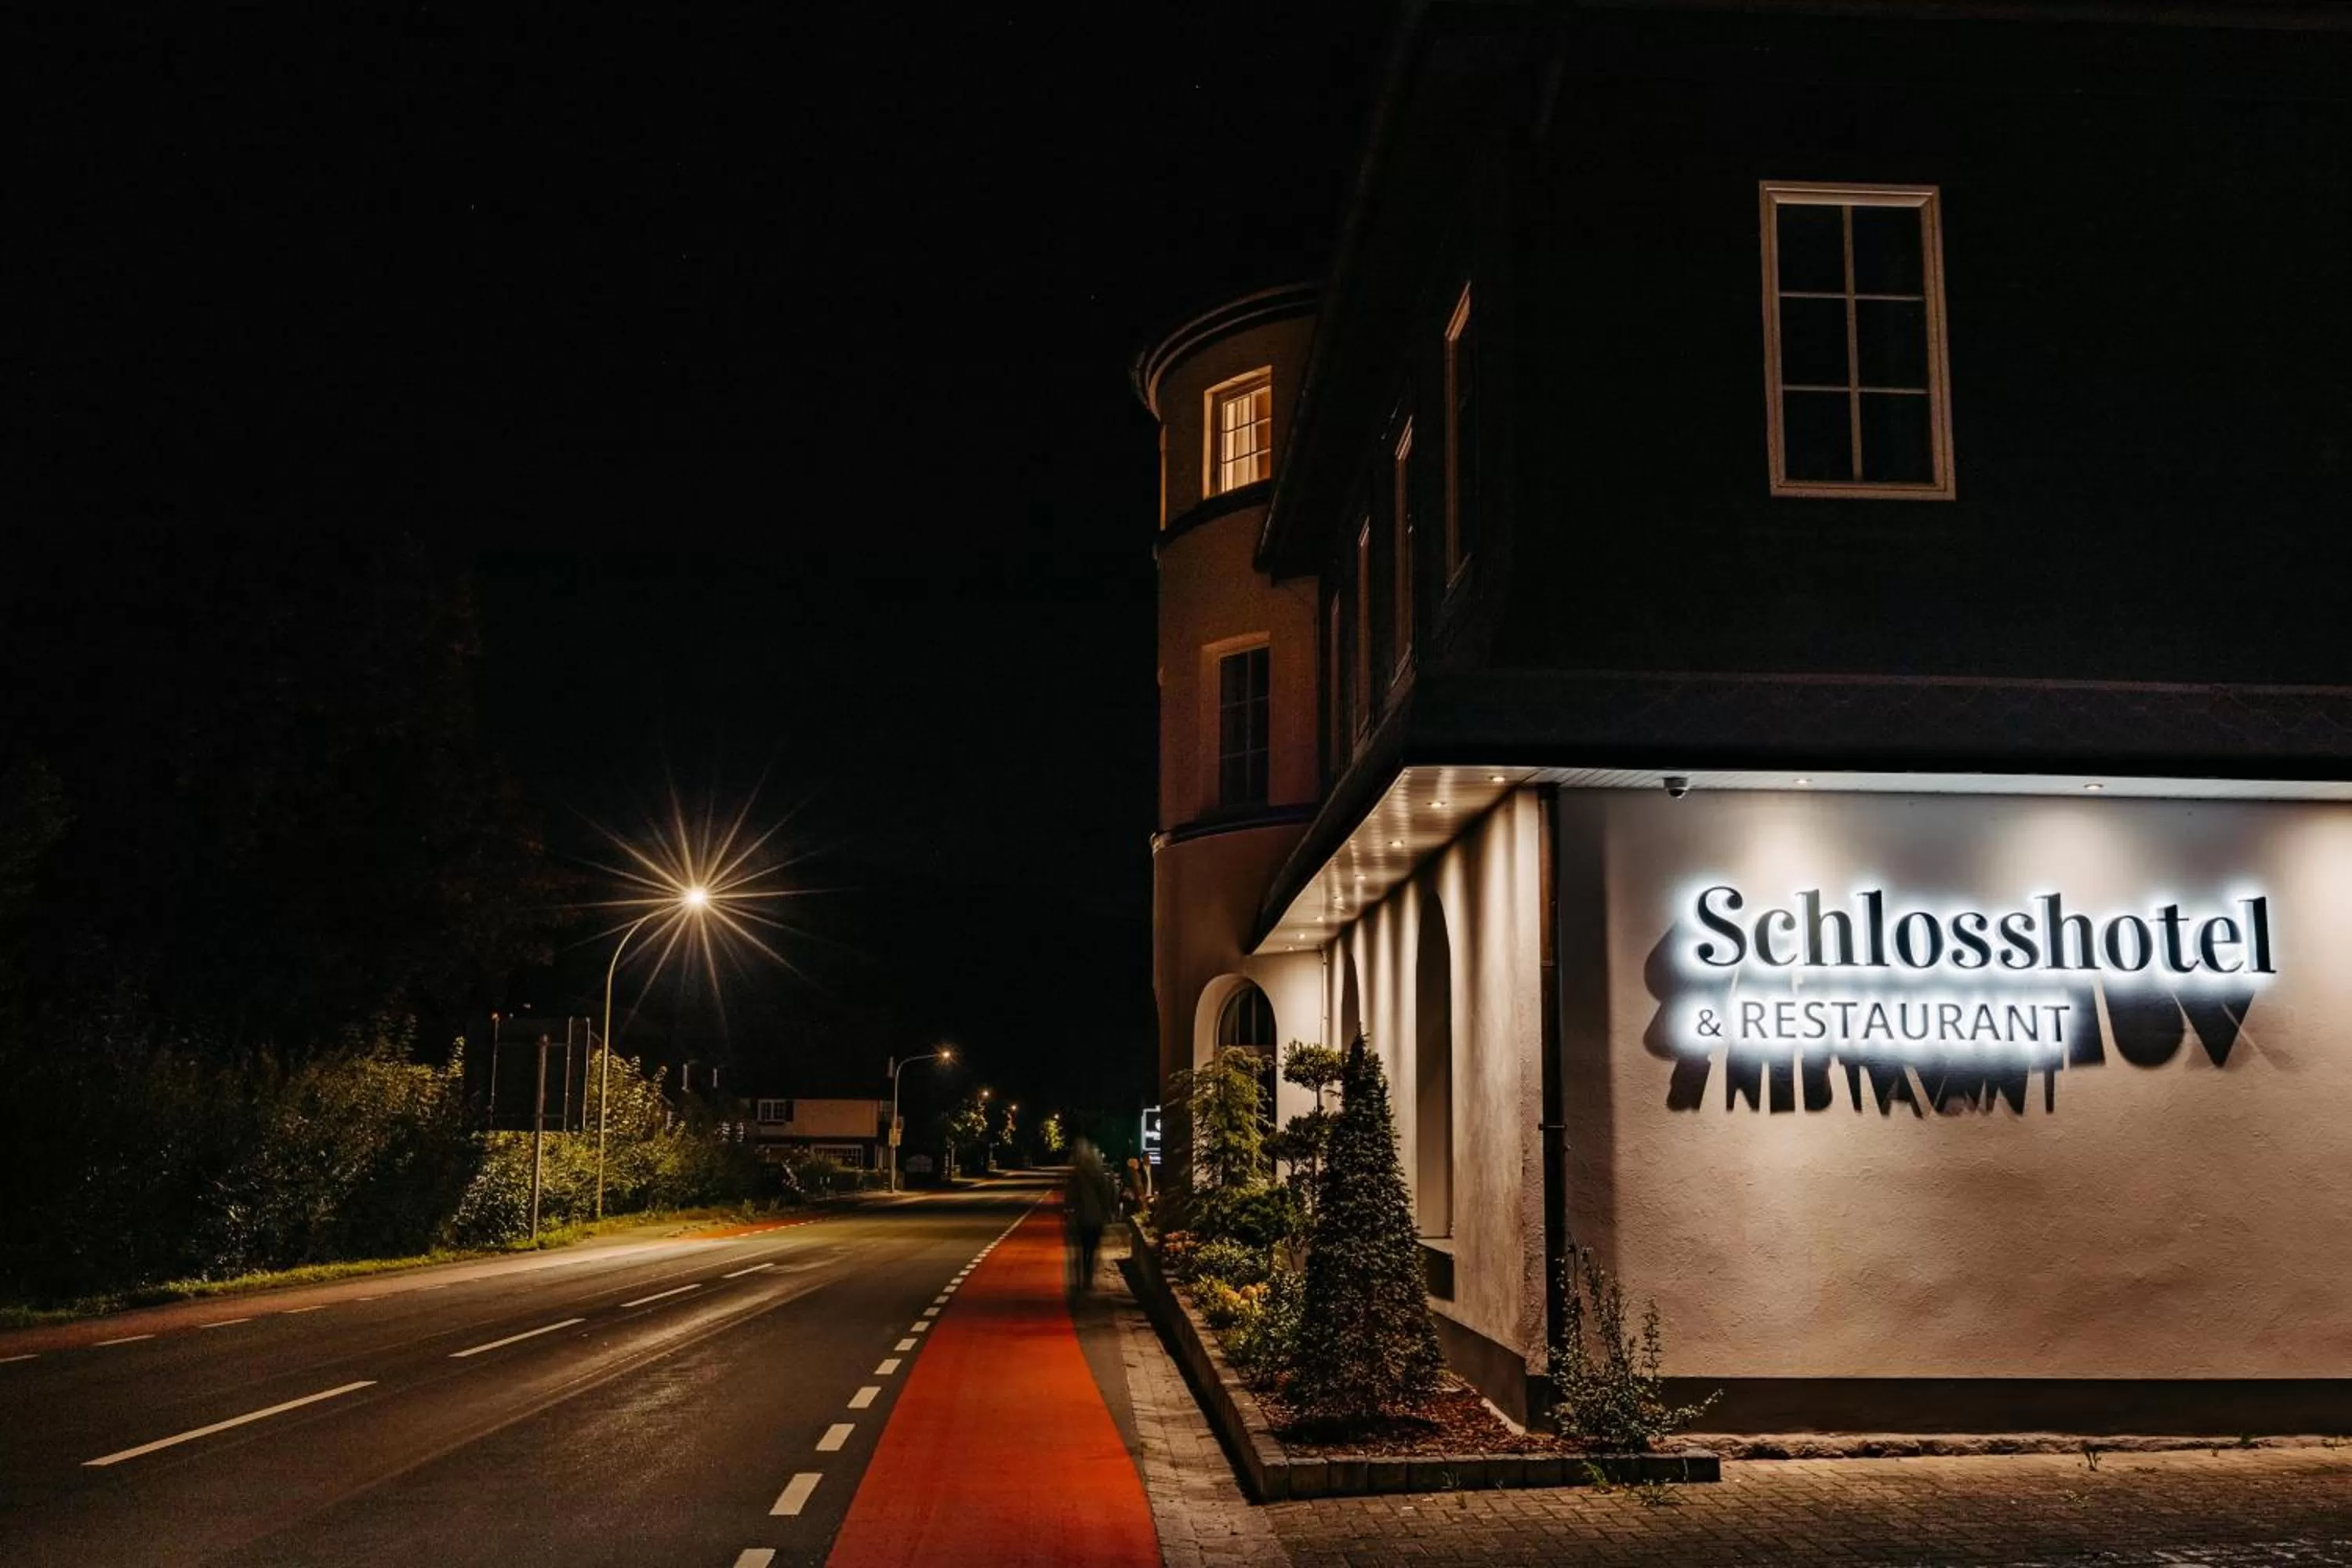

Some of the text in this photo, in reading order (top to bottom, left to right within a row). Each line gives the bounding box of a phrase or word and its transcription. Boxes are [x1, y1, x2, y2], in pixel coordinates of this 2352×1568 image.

[1696, 886, 2277, 974] Schlosshotel
[1697, 1001, 2071, 1042] & RESTAURANT
